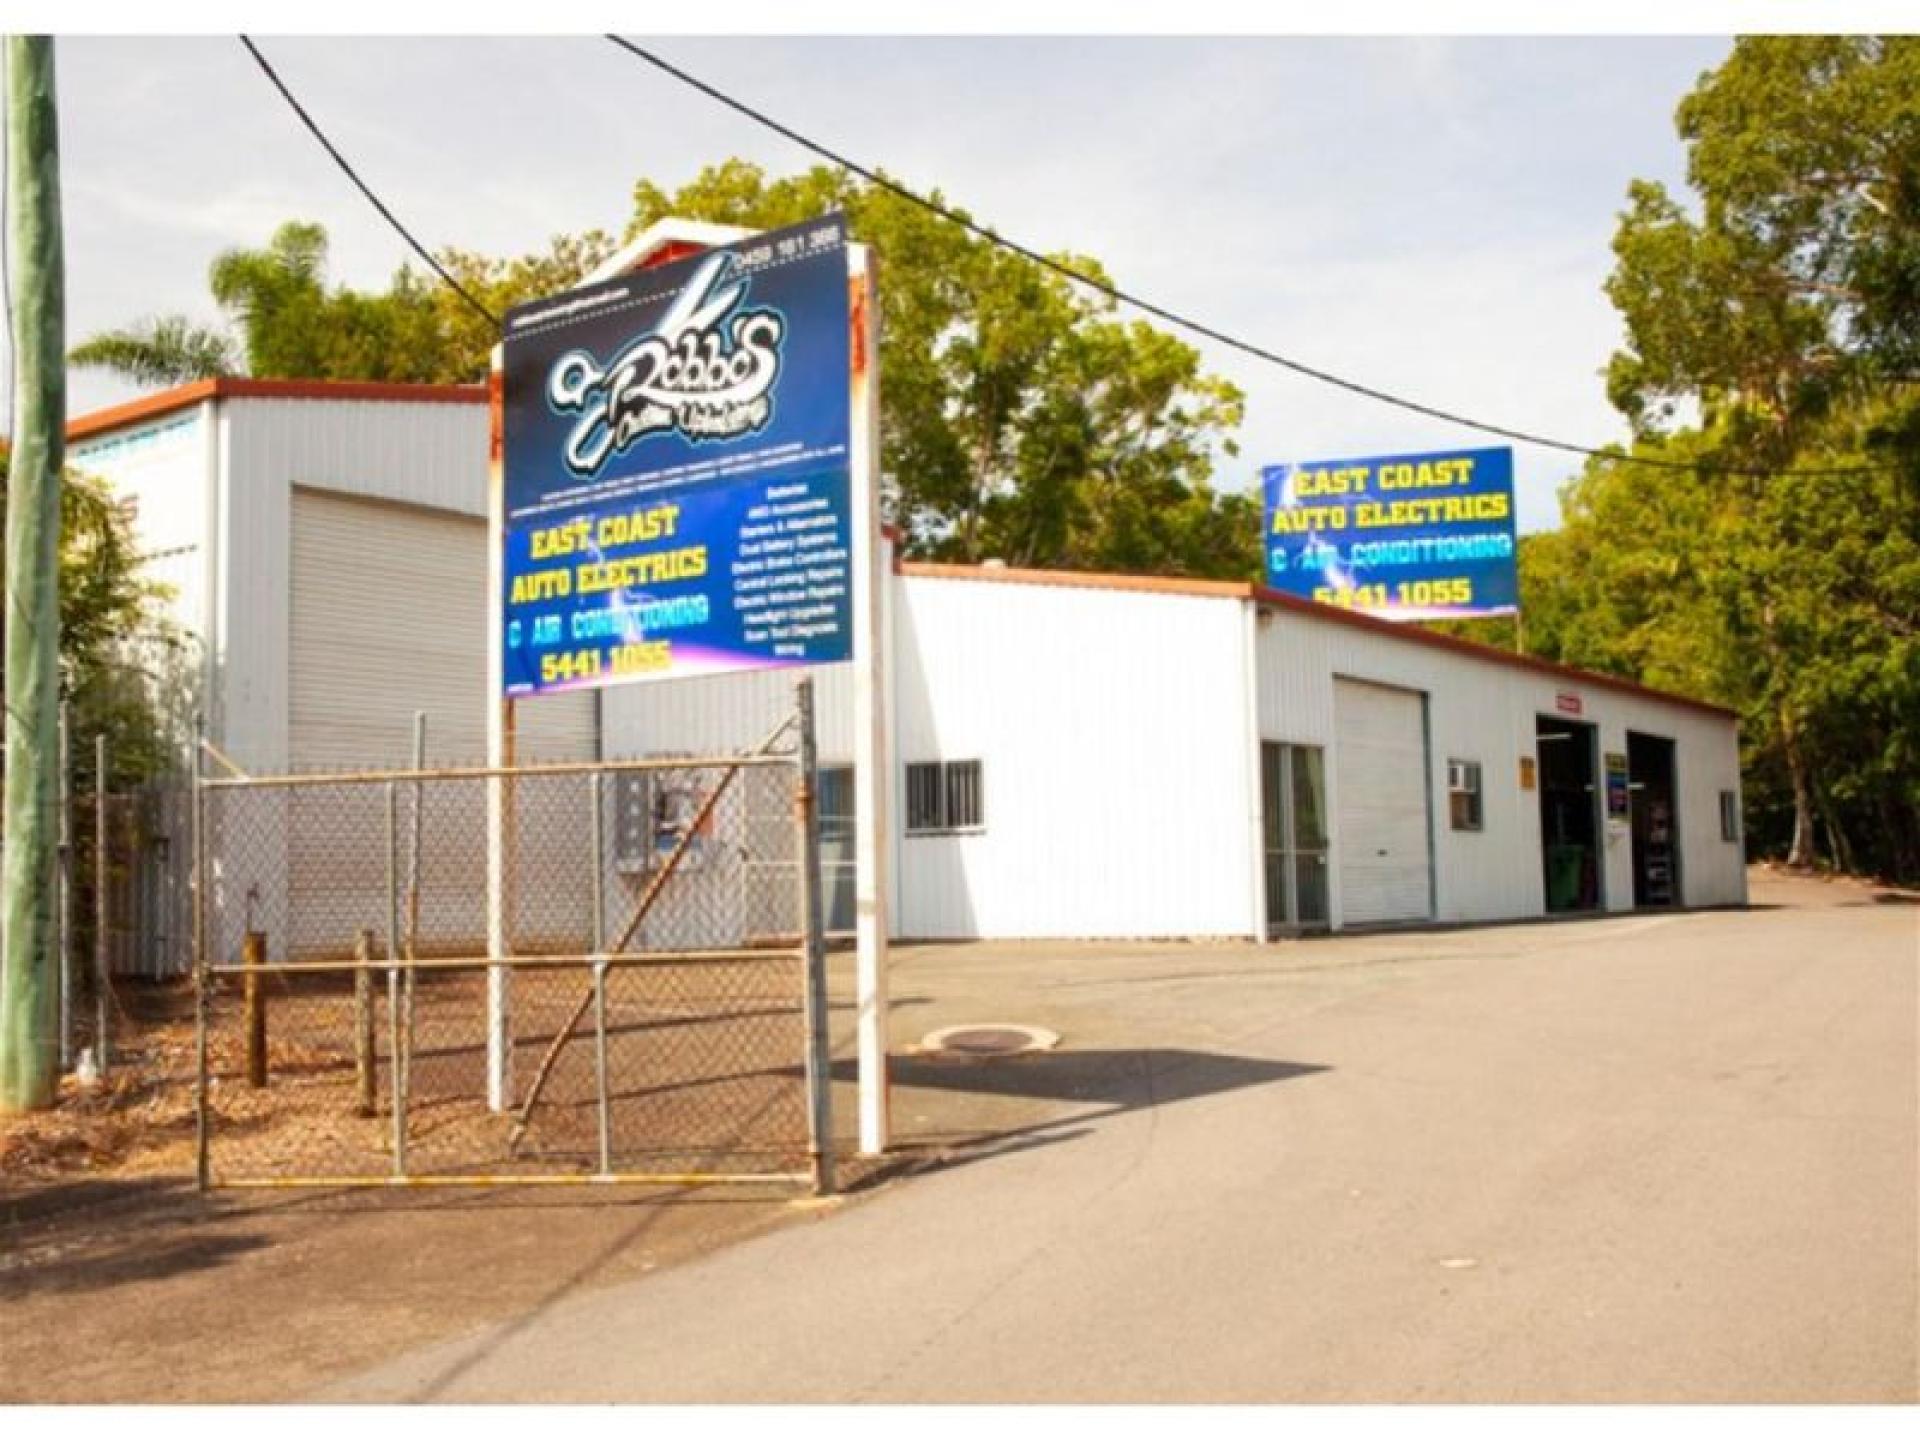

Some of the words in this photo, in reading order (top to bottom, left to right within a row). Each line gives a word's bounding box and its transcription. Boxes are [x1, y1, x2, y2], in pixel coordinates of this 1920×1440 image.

[1294, 467, 1370, 496] EAST
[1378, 458, 1475, 489] COAST
[530, 522, 593, 559] EAST
[600, 505, 680, 547] COAST
[1271, 506, 1346, 533] AUTO
[1355, 492, 1508, 527] ELECTRICS
[1351, 533, 1513, 568] CONDITIONING
[511, 568, 571, 604] AUTO
[576, 546, 708, 592] ELECTRICS
[1397, 577, 1473, 607] 1055
[533, 615, 562, 645] AIR
[541, 650, 600, 682] 5441
[610, 640, 672, 674] 1055
